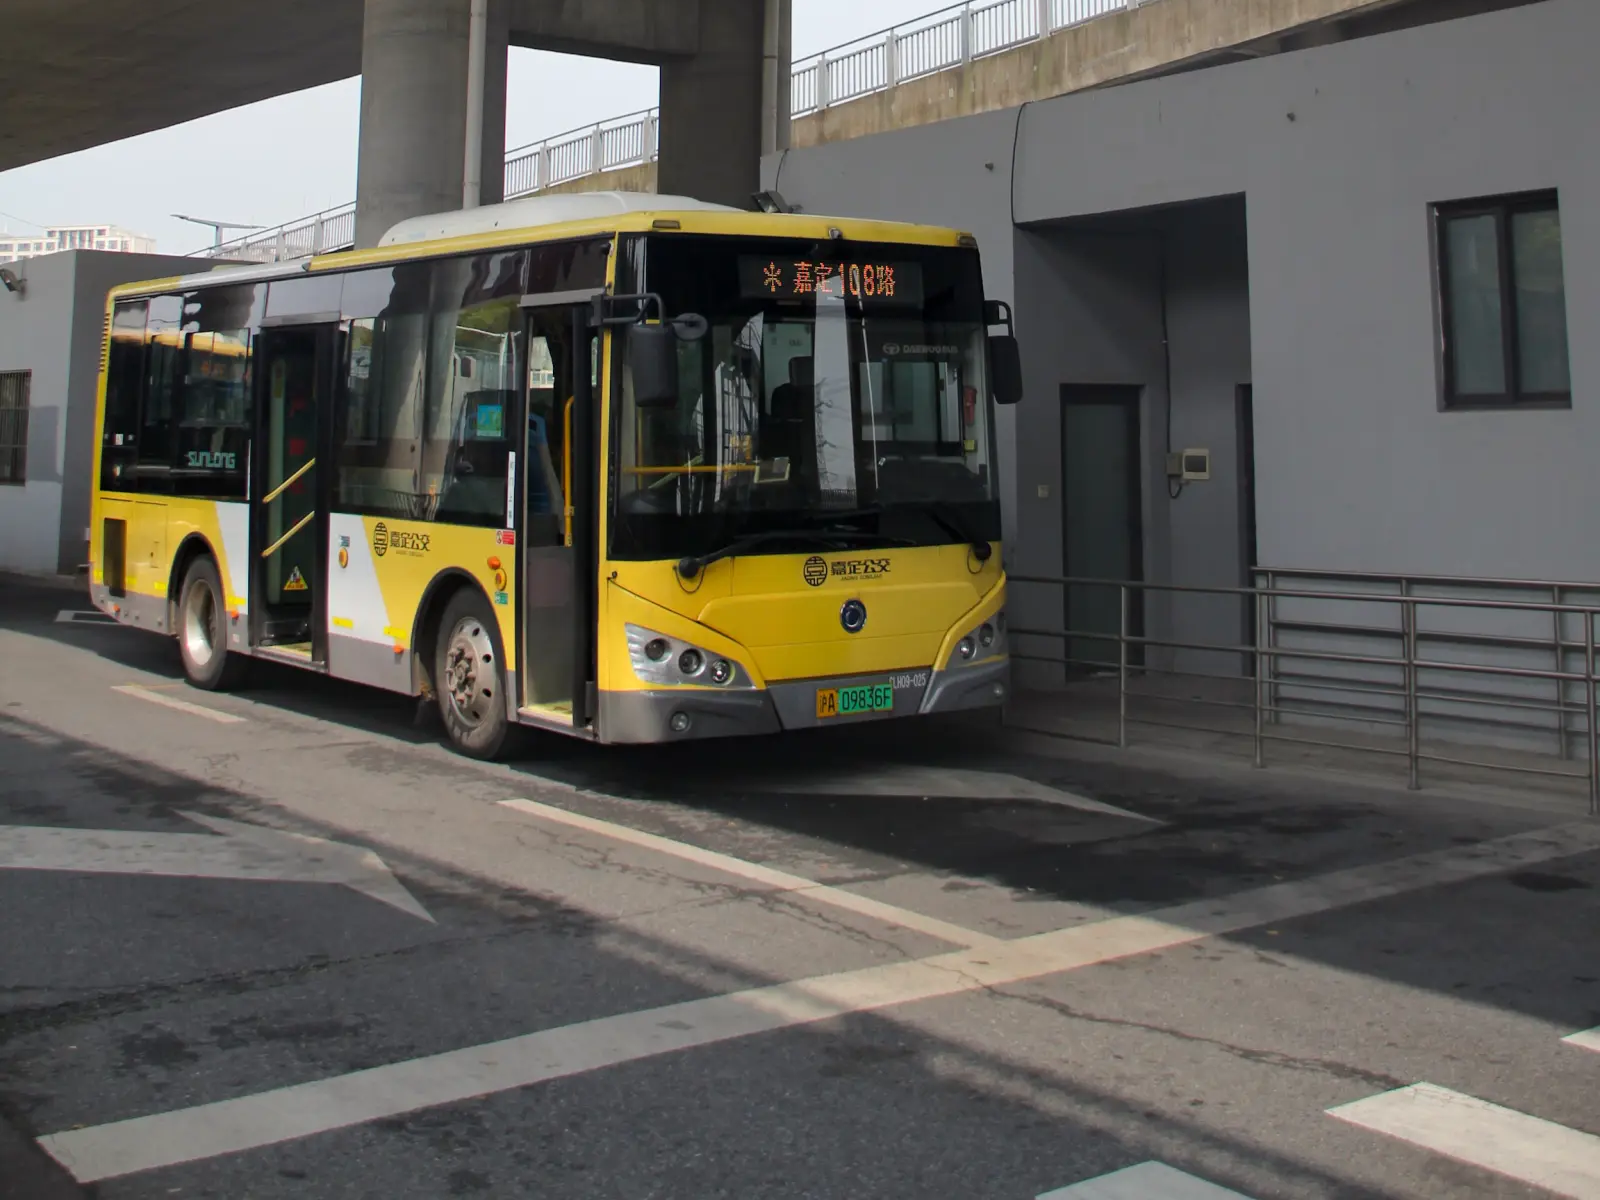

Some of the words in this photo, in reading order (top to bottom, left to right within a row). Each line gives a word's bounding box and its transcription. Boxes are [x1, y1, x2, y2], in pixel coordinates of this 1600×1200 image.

[793, 261, 896, 296] 嘉定108路
[188, 451, 235, 469] SUNLONG
[390, 531, 430, 552] 嘉定公交
[831, 558, 891, 576] 嘉定公交
